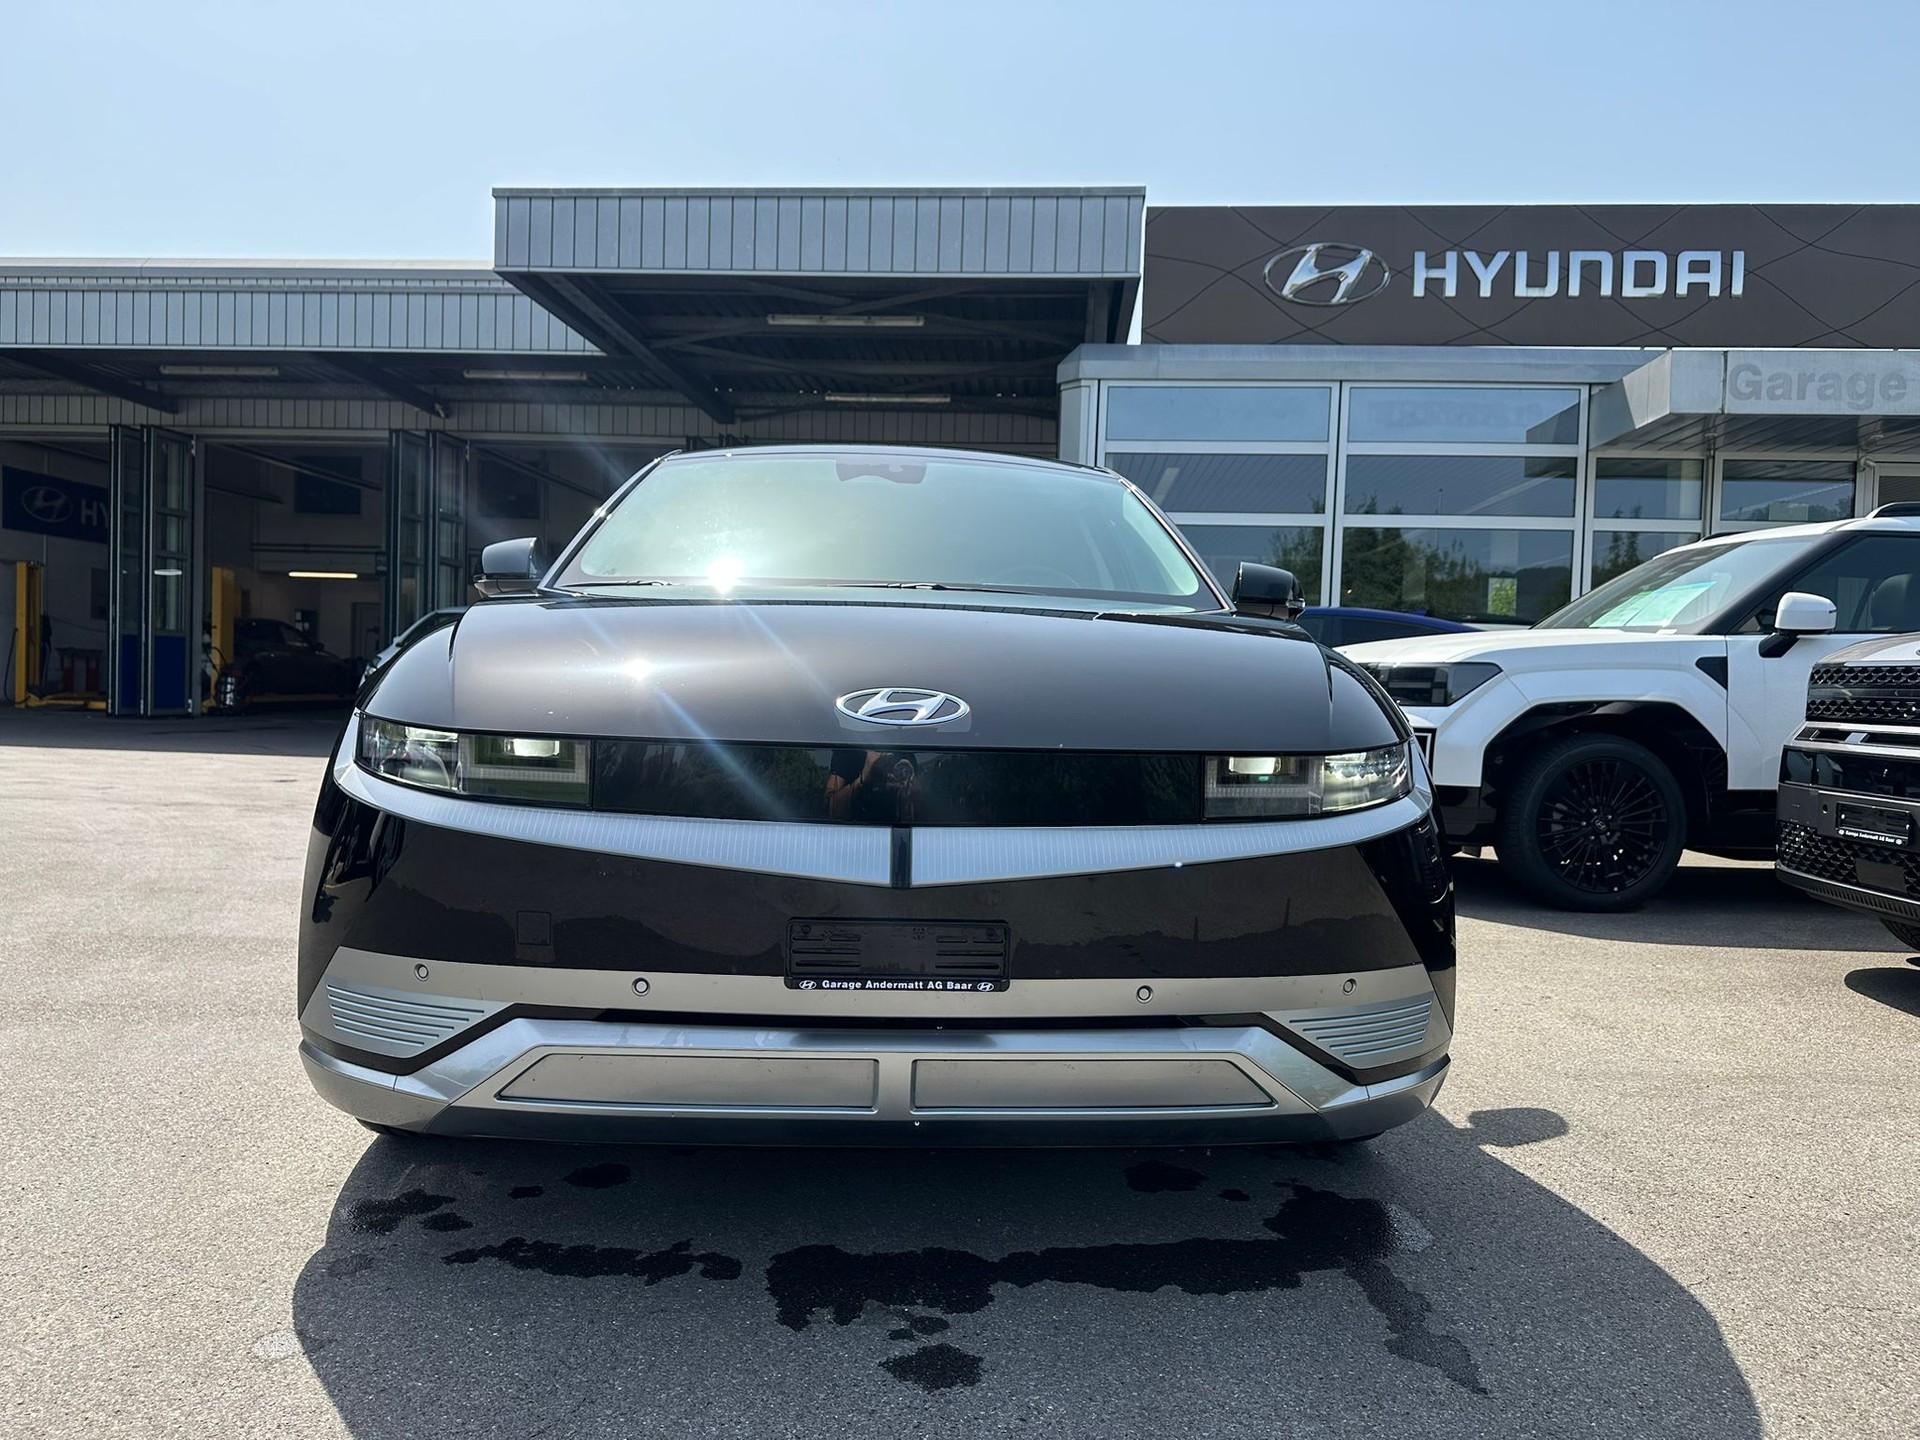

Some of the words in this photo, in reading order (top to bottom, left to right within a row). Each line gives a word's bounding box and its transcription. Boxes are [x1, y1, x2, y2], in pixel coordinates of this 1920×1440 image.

[1412, 250, 1746, 298] HYUNDAI
[1729, 363, 1908, 411] Garage
[822, 980, 862, 990] Garage
[865, 980, 924, 989] Andermatt
[927, 981, 943, 990] AG
[946, 981, 973, 990] Baar
